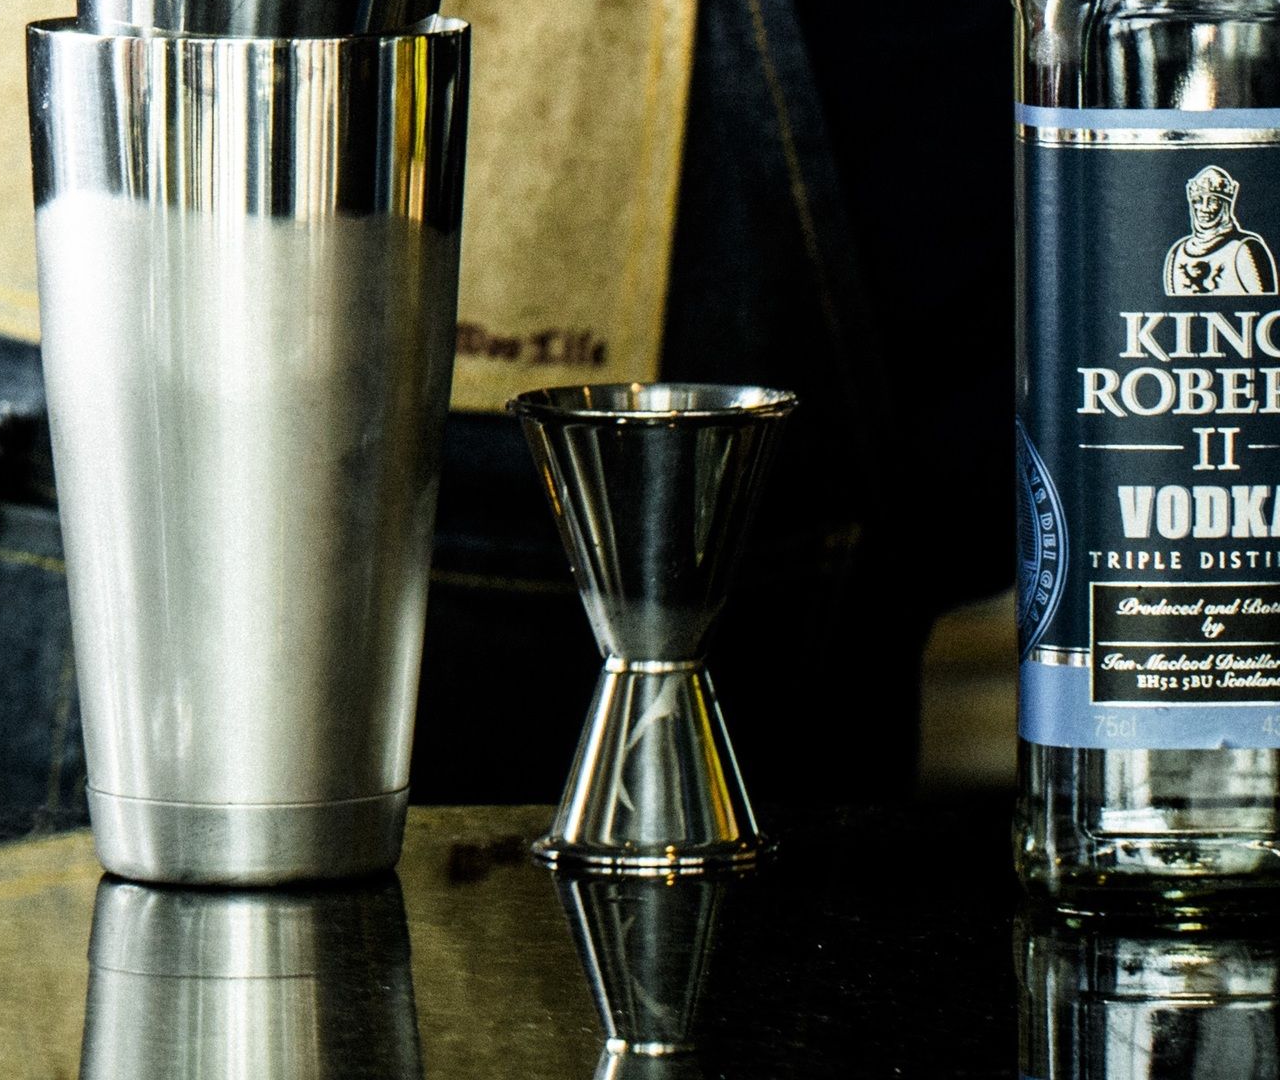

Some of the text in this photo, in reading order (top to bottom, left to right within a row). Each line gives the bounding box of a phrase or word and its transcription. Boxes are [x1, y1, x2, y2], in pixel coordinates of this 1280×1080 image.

[1193, 427, 1240, 470] II
[1118, 485, 1280, 539] VODK
[1089, 551, 1280, 570] TRIPLE DISTI
[1116, 597, 1204, 616] Produced
[1204, 599, 1241, 615] and
[1201, 616, 1225, 638] by
[1137, 653, 1214, 670] Macleod
[1137, 674, 1178, 690] EH52
[1182, 674, 1214, 690] 5BU
[1094, 715, 1137, 737] 75cl
